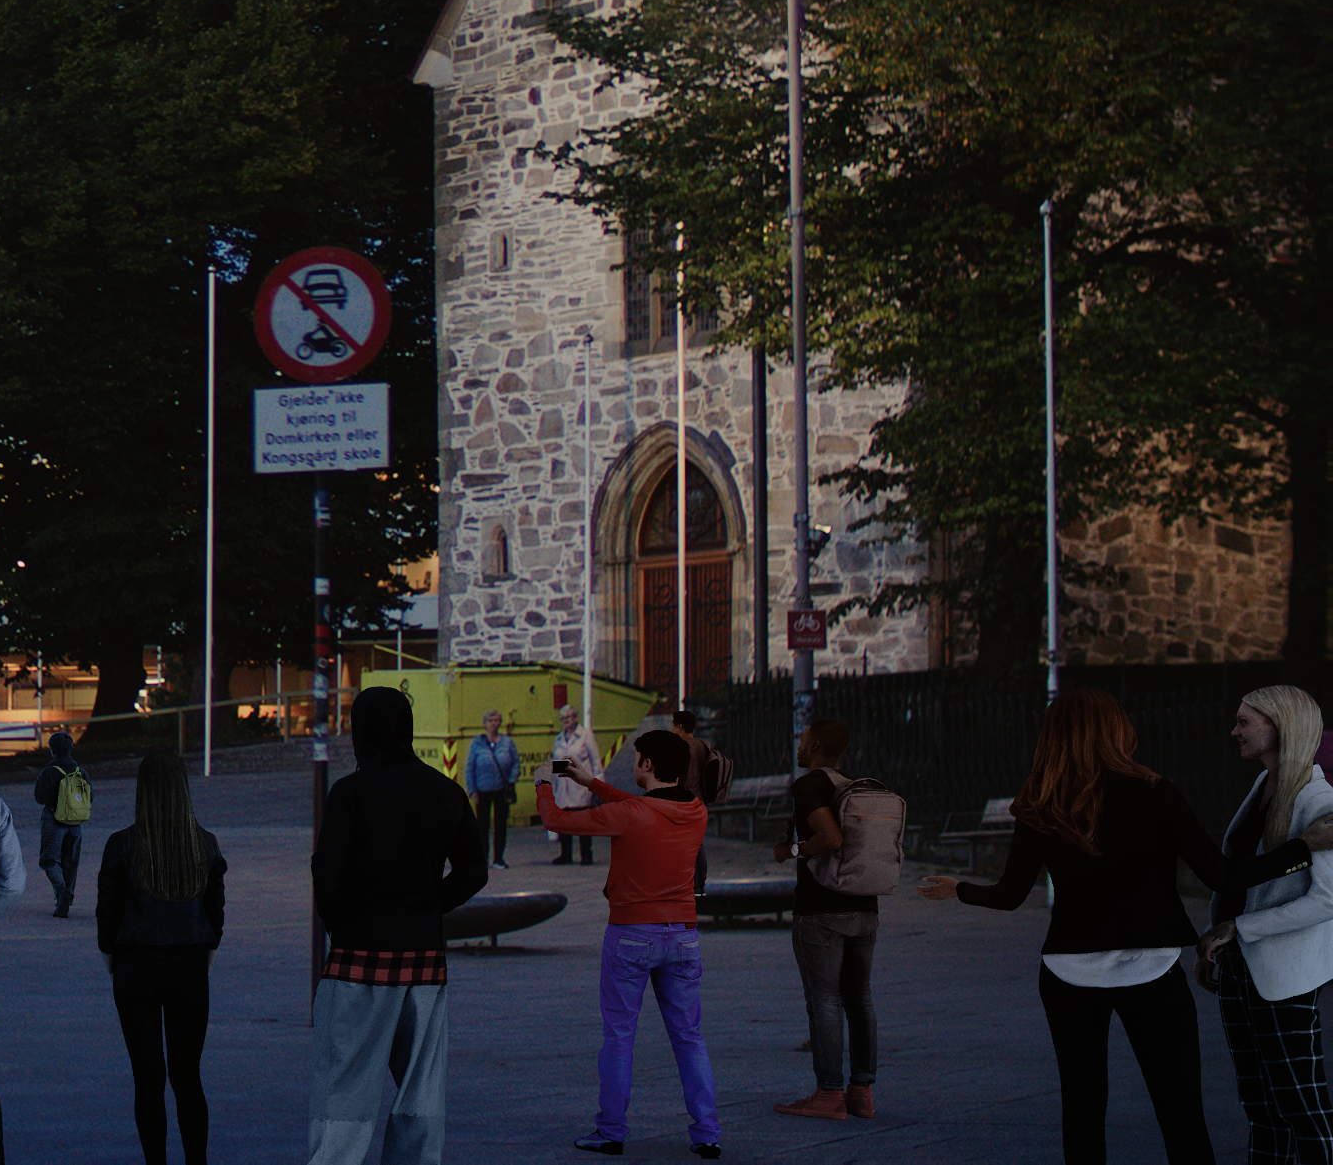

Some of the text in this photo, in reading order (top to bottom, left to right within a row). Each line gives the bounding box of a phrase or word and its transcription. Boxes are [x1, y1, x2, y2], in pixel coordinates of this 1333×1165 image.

[278, 392, 364, 410] Gjelder ikke
[286, 410, 356, 427] kjøring til
[265, 429, 378, 445] Domkirken eller
[262, 447, 382, 466] Kongsgård skole
